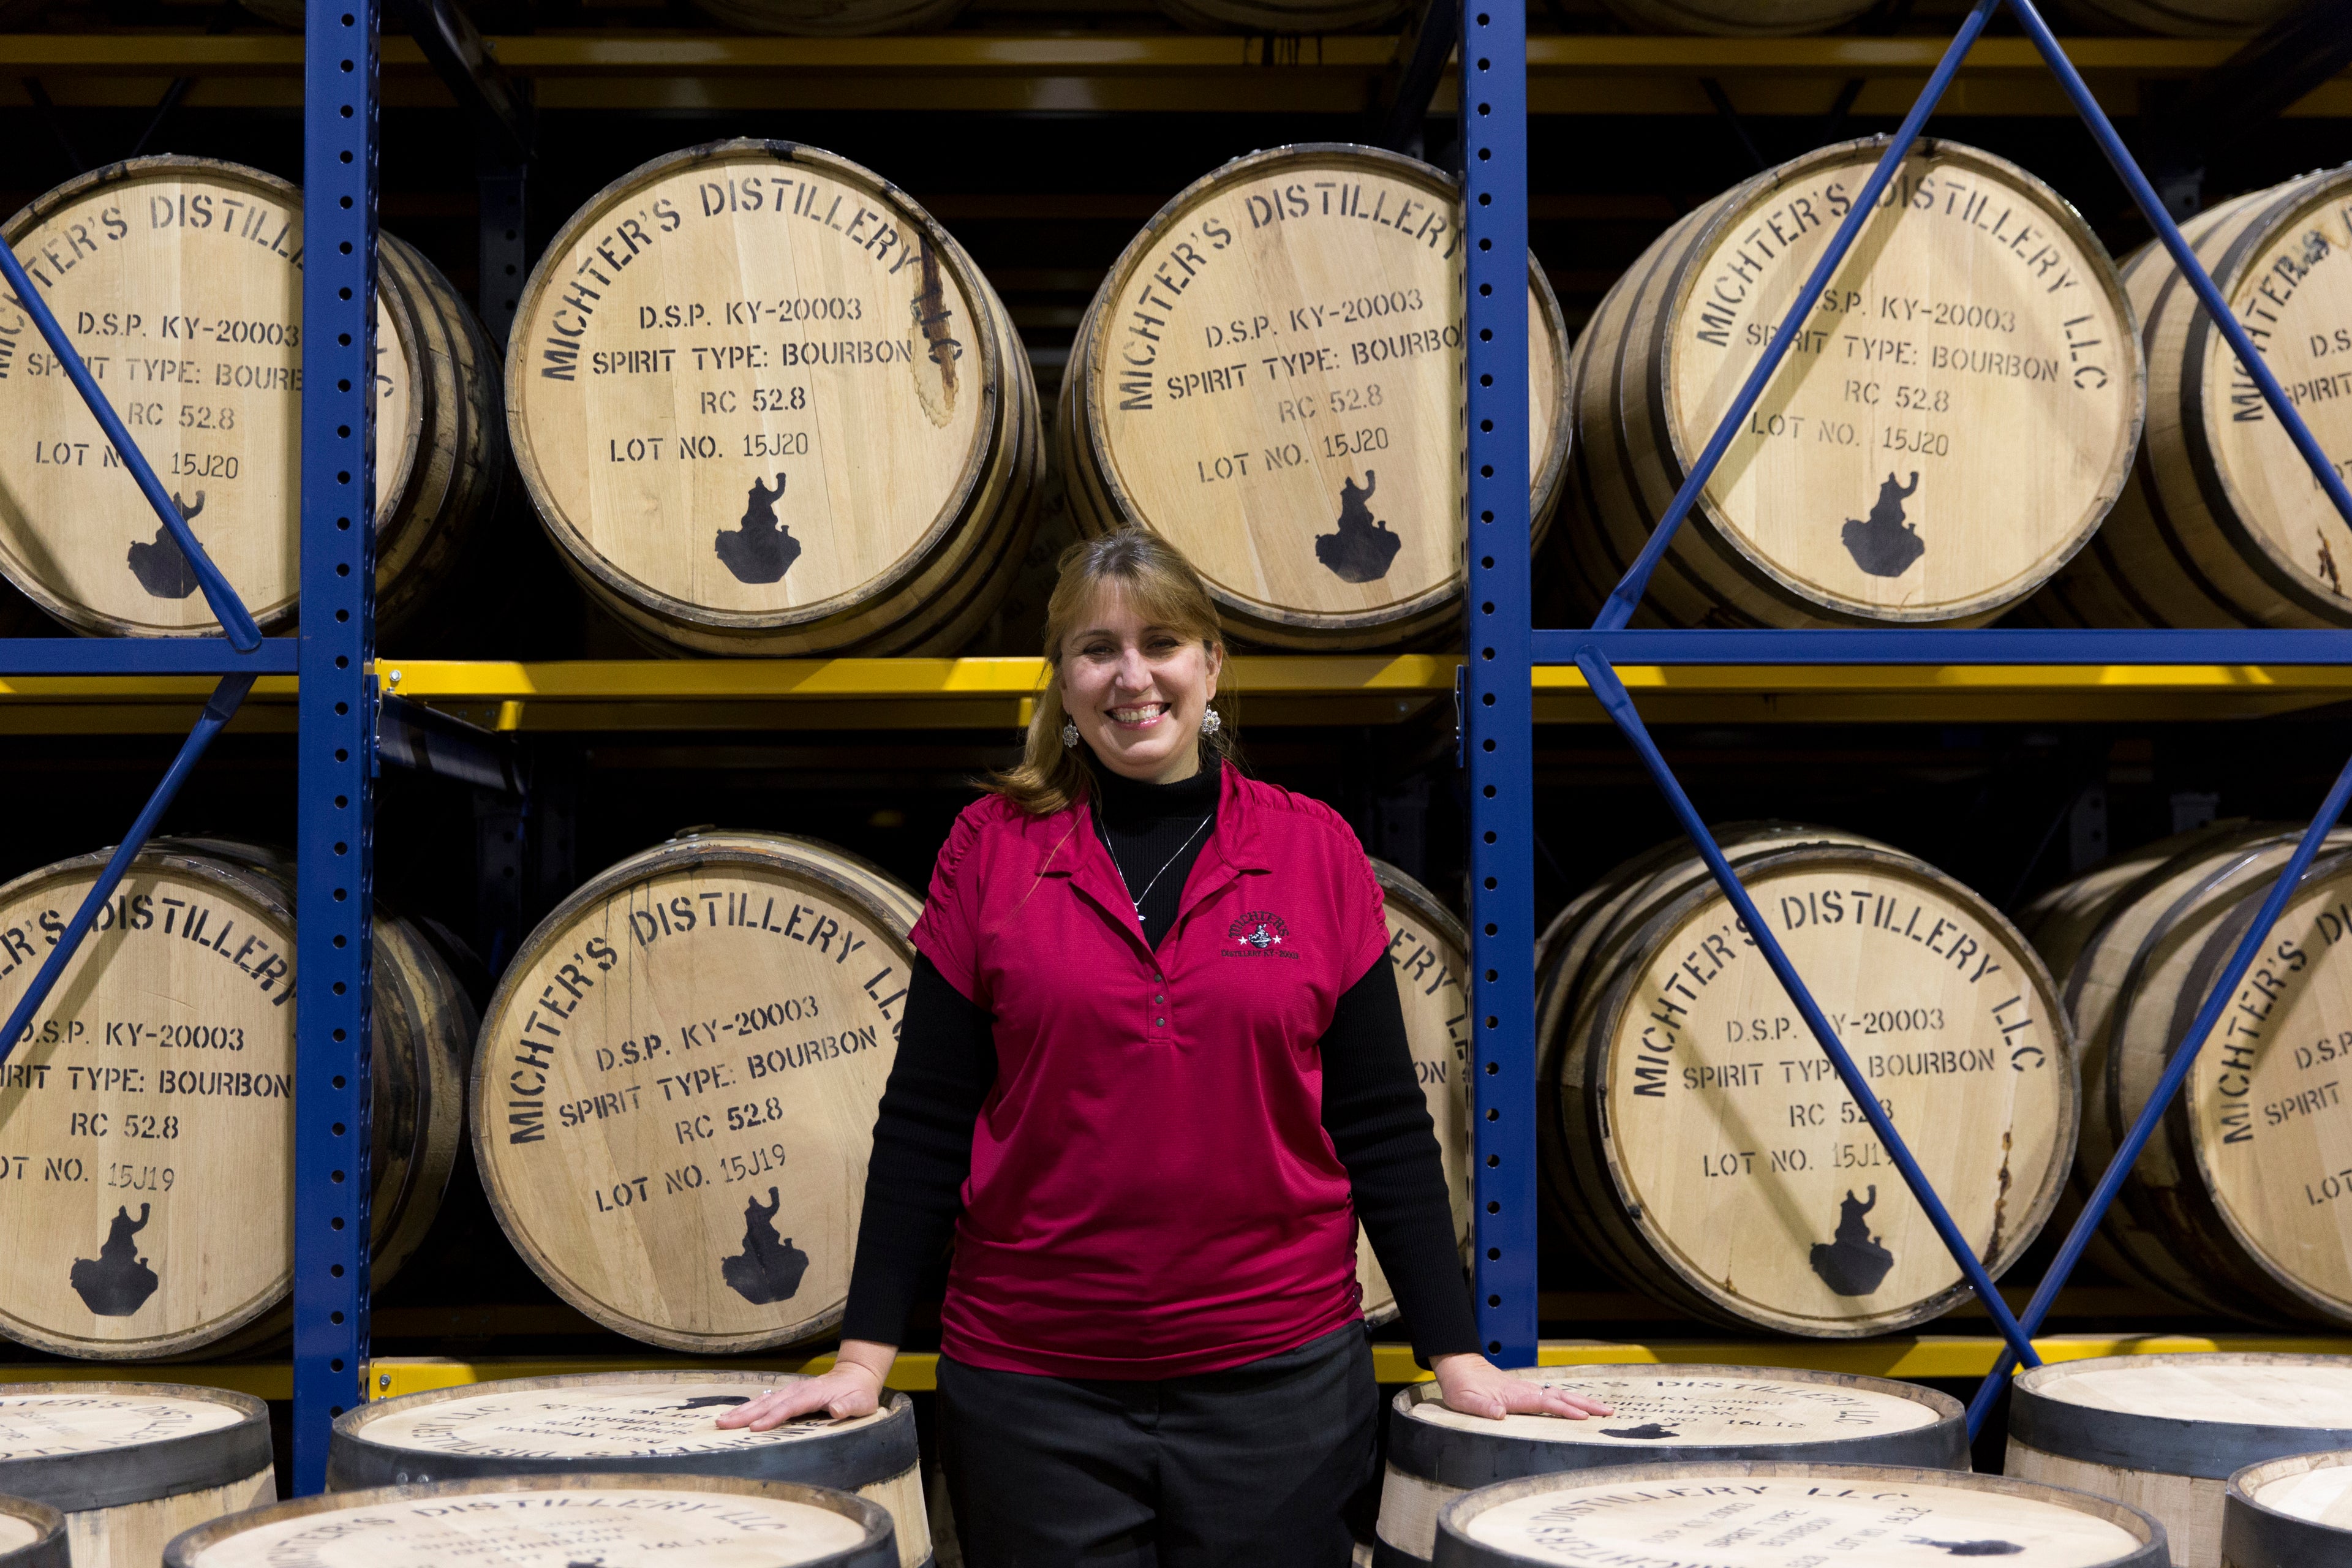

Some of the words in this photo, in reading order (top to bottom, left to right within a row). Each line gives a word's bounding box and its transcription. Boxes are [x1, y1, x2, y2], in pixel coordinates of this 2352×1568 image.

[541, 197, 682, 382] MICHTER'S
[699, 177, 922, 277] DISTILLERY
[1696, 183, 1850, 348] MICHTER'S
[2064, 314, 2108, 391] LLC
[639, 303, 712, 330] D.S.P.
[726, 297, 863, 325] KY-20003
[1119, 217, 1232, 411] MICHTER'S
[1205, 316, 1278, 349] D.S.P.
[1290, 288, 1424, 334] KY-20003
[1799, 284, 1867, 317] .S.P.
[1881, 296, 2016, 334] KY-20003
[77, 312, 148, 337] D.S.P.
[161, 315, 300, 348] KY-20003
[26, 353, 110, 382] SPIT
[125, 357, 201, 385] TYPE:
[592, 349, 676, 375] SPIRIT
[692, 346, 769, 369] TYPE:
[782, 339, 913, 366] BOURBON
[1167, 364, 1247, 401] SPIRIT
[1262, 348, 1340, 385] TYPE:
[1351, 325, 1465, 366] BOURBO
[1746, 323, 1828, 355] SPRIT
[1843, 335, 1918, 368] TYPE:
[1932, 346, 2060, 383] BOURBON
[700, 390, 737, 415] RC
[752, 386, 807, 412] 52.8
[1278, 396, 1316, 424] RC
[1329, 384, 1385, 413] 52.8
[1845, 380, 1880, 405] RC
[1894, 386, 1951, 413] 52.8
[128, 402, 164, 426] RC
[179, 405, 235, 431] 52.8
[1751, 412, 1806, 439] LOT
[1818, 421, 1861, 448] NO.
[1882, 426, 1951, 457] 15J20
[36, 442, 90, 466] LOT
[170, 453, 239, 480] 15J20
[609, 438, 664, 463] LOT
[679, 435, 723, 461] NO.
[742, 432, 809, 458] 15J20
[1197, 453, 1250, 484] LOT
[1264, 443, 1310, 472] NO.
[1323, 427, 1390, 459] 15J20
[1228, 910, 1289, 938] MICHTER'S
[0, 908, 66, 980] R'S
[1781, 890, 2001, 983] DISTILLERY
[1992, 995, 2046, 1072] LLC
[106, 1022, 245, 1051] KY-20003
[508, 937, 618, 1145] MICHTER'S
[629, 892, 867, 965] DISTILLERY
[595, 1034, 671, 1072] D.S.P.
[682, 995, 820, 1051] KY-20003
[1727, 1017, 1797, 1043] D.S.P.
[1813, 1008, 1945, 1039] Y-20003
[2218, 940, 2307, 1145] MICHTER'S
[67, 1066, 145, 1093] TYPE:
[159, 1071, 291, 1099] BOURBON
[559, 1085, 642, 1128] SPIRIT
[657, 1065, 736, 1102] TYPE:
[747, 1025, 878, 1081] BOURBON
[1683, 1063, 1764, 1090] SPIRIT
[1868, 1048, 1995, 1079] BOURBON
[676, 1115, 714, 1145] RC
[728, 1097, 784, 1133] 52.8
[1790, 1104, 1825, 1128] RC
[1841, 1098, 1893, 1125] 58
[2264, 1081, 2340, 1126] SPIRIT
[71, 1113, 108, 1137] RC
[123, 1115, 179, 1140] 52.8
[44, 1158, 89, 1183] NO.
[107, 1163, 175, 1193] 15J19
[595, 1177, 649, 1213] LOT
[666, 1165, 710, 1196] NO.
[720, 1144, 786, 1185] 15J19
[1704, 1152, 1756, 1177] LOT
[1771, 1148, 1814, 1173] NO.
[0, 1399, 133, 1409] TER'S
[1561, 1382, 1629, 1391] R'S
[1657, 1381, 1871, 1406] DISTILLERY
[1833, 1410, 1880, 1425] LLC
[1612, 1406, 1738, 1416] OURBON
[410, 1498, 723, 1517] DISTILLERY
[712, 1511, 788, 1531] LLC
[1528, 1486, 1770, 1523] DISTILLERY
[1807, 1487, 1910, 1502] LLC
